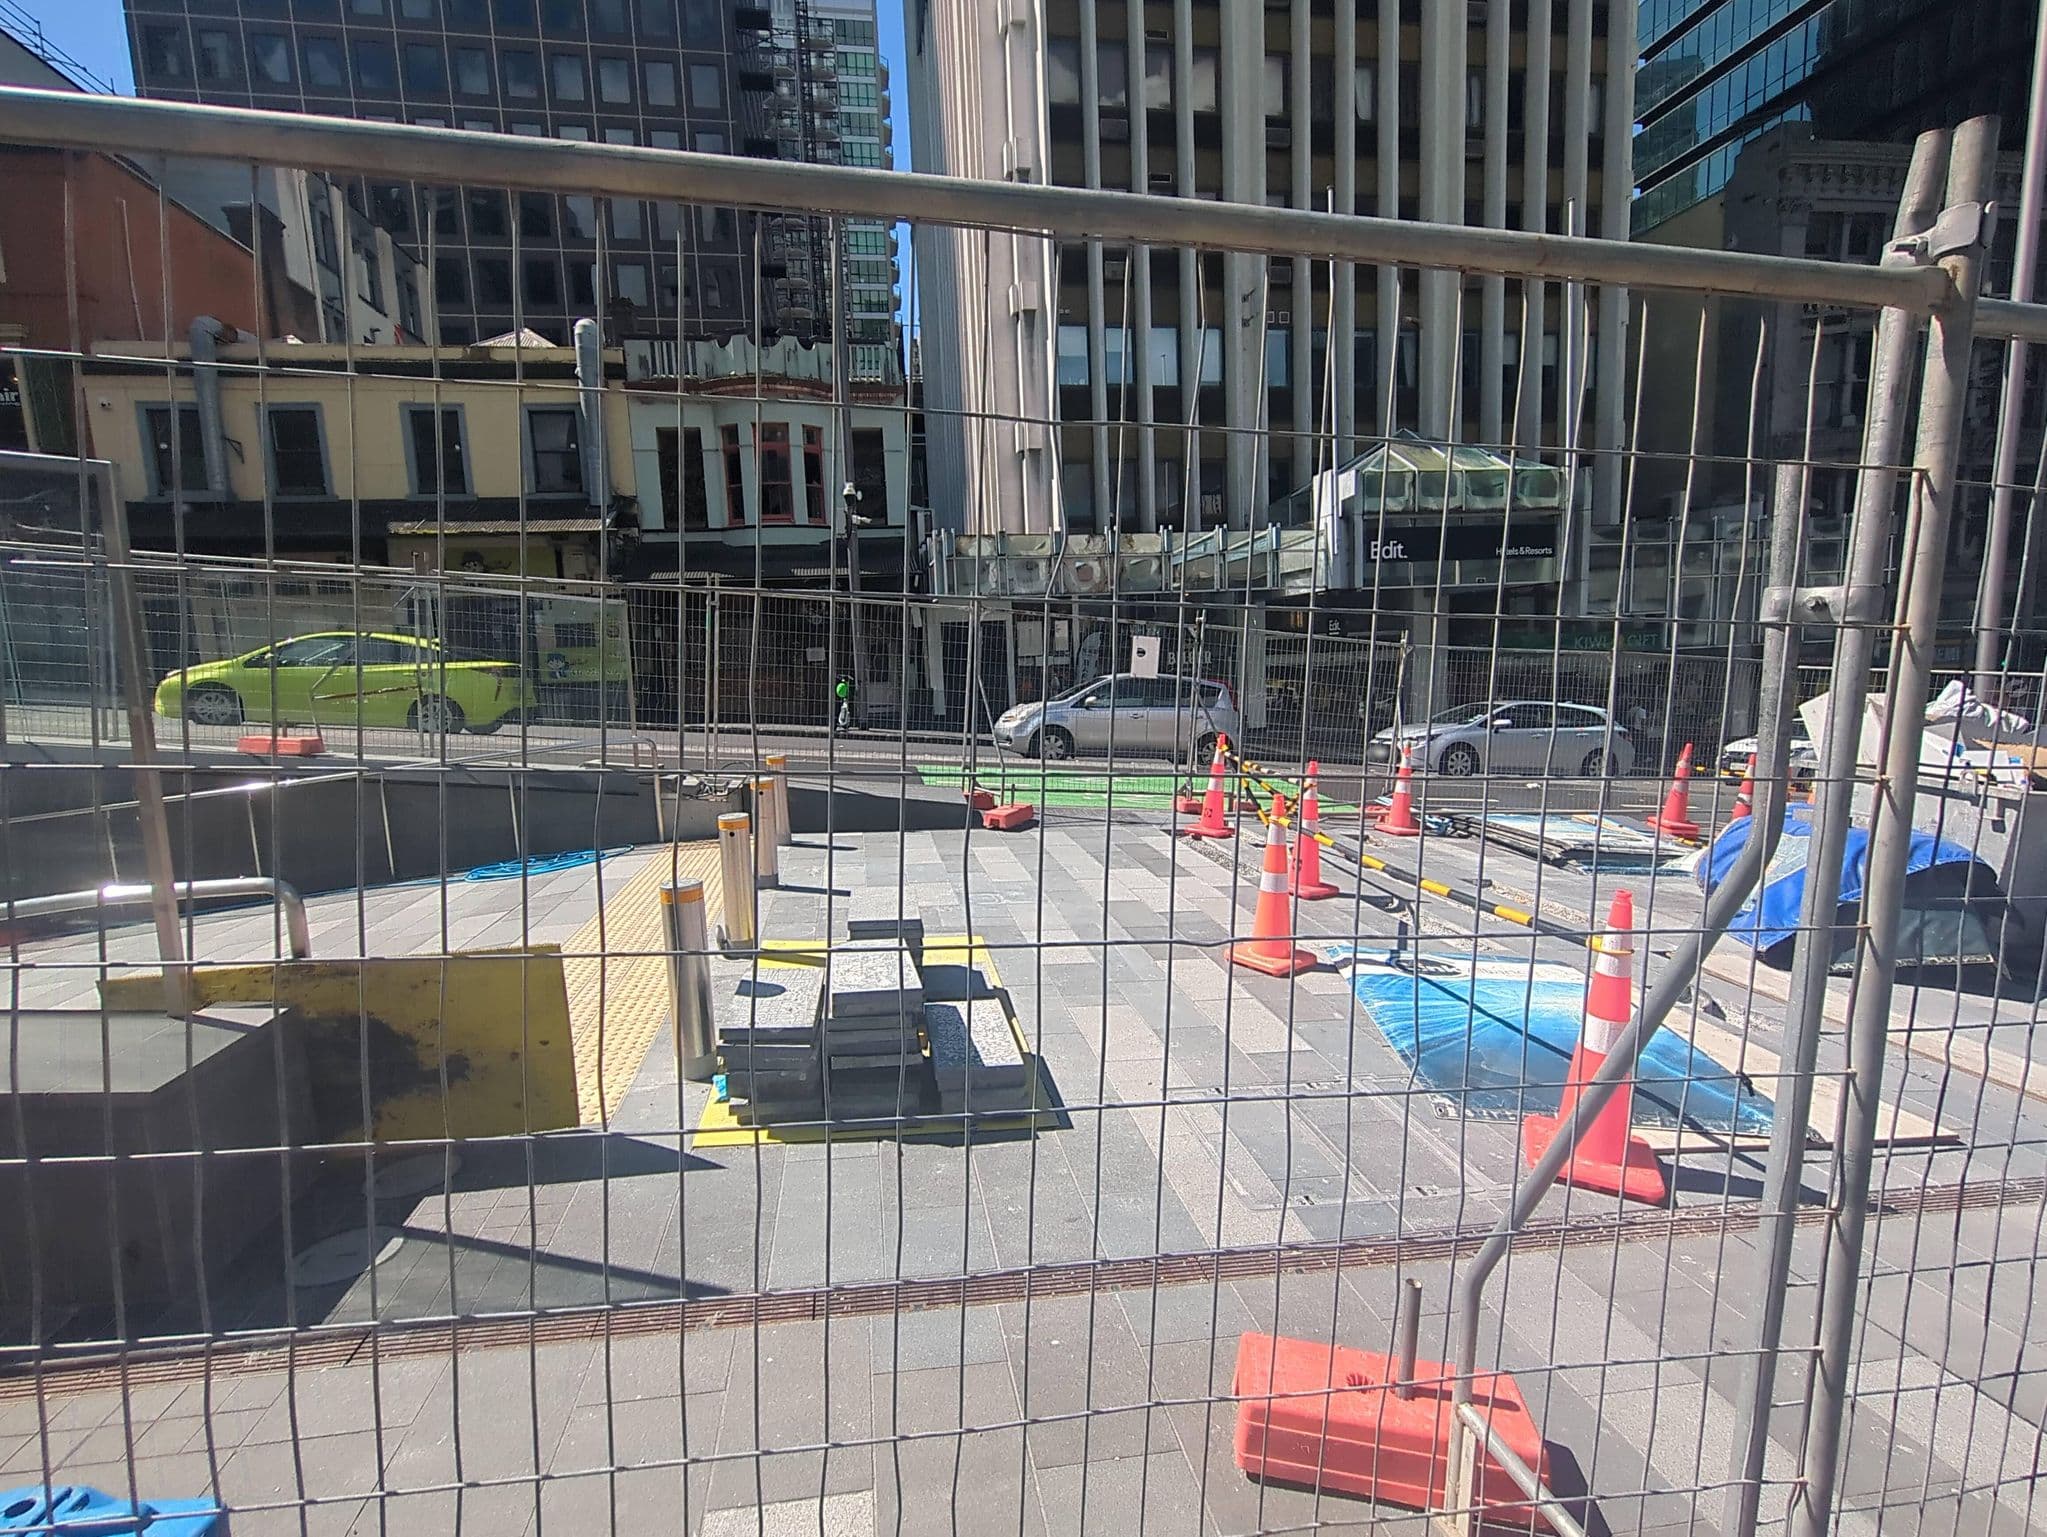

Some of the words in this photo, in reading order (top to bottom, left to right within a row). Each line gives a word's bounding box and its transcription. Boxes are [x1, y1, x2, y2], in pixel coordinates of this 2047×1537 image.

[1371, 540, 1408, 559] Edit.
[1496, 546, 1519, 556] Htels
[1525, 546, 1553, 555] Resorts
